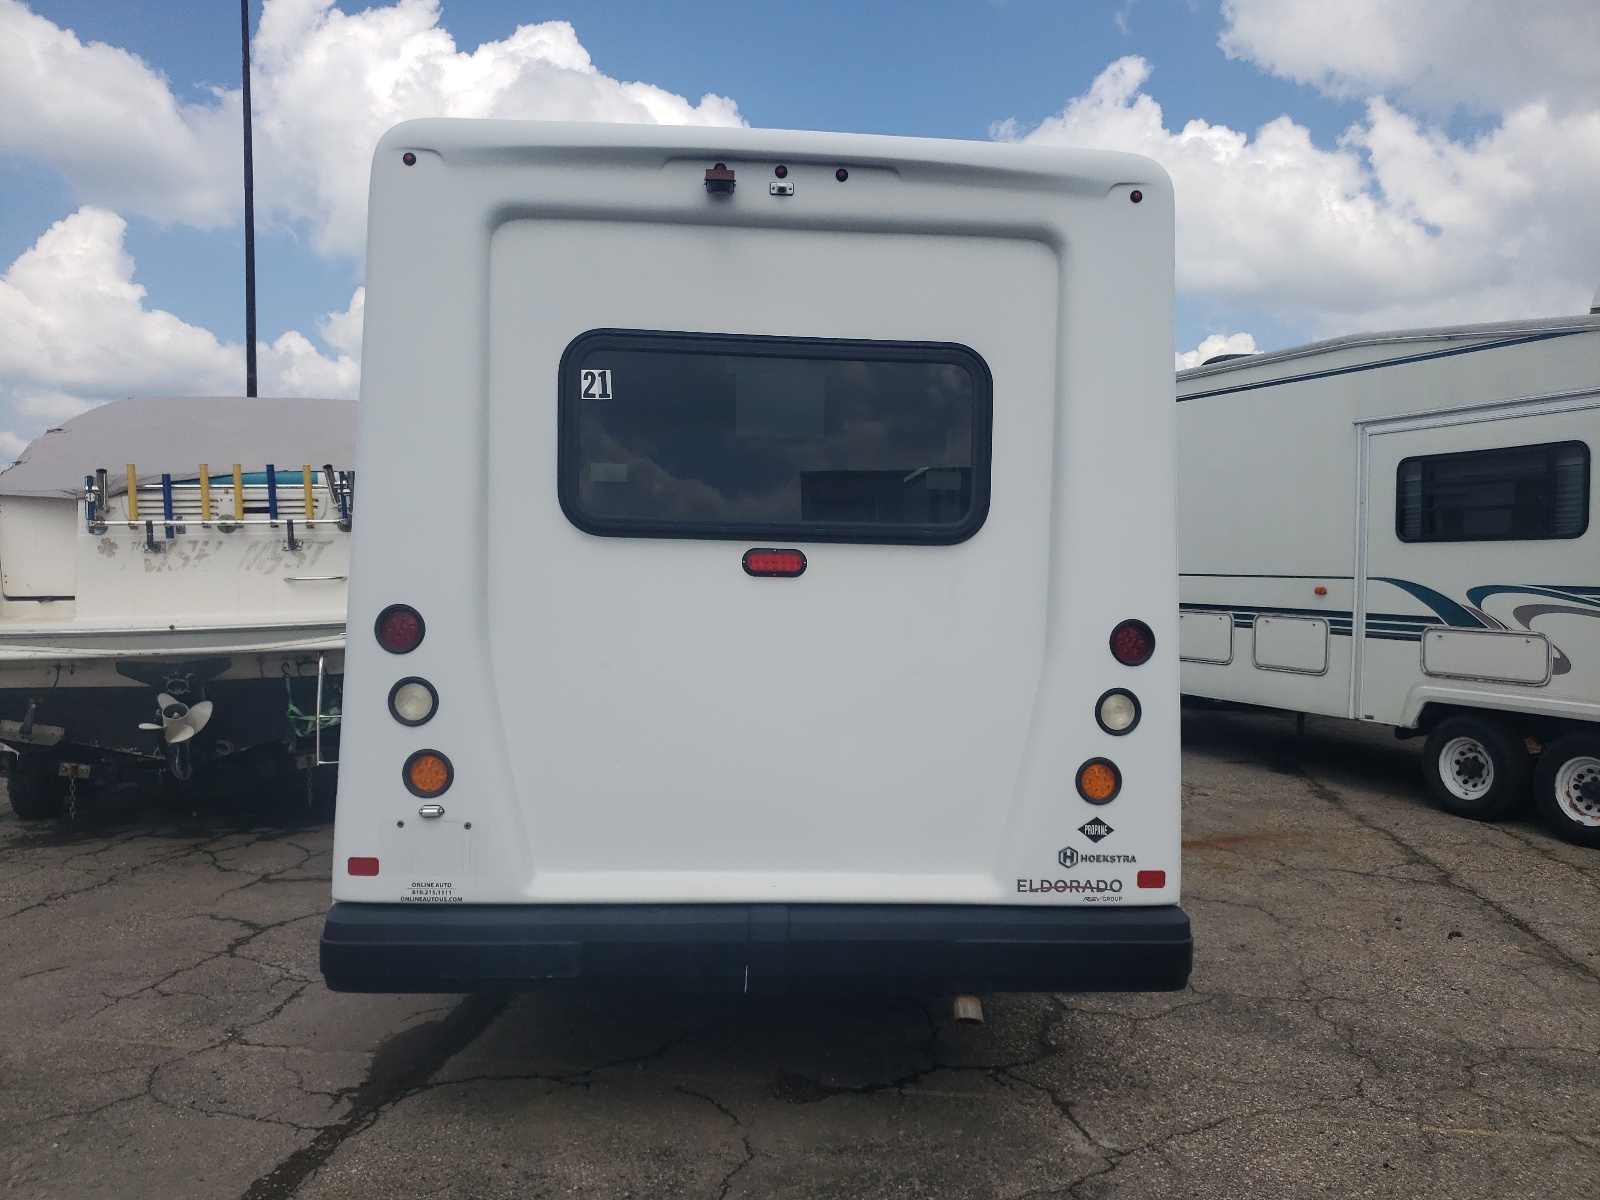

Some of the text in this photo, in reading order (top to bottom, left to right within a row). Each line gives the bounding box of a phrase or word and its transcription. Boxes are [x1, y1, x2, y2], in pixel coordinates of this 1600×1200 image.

[583, 371, 610, 398] 21
[1084, 824, 1108, 835] PROPANE
[1080, 854, 1137, 863] HOEKSTRA
[1017, 878, 1123, 893] ELDORADO
